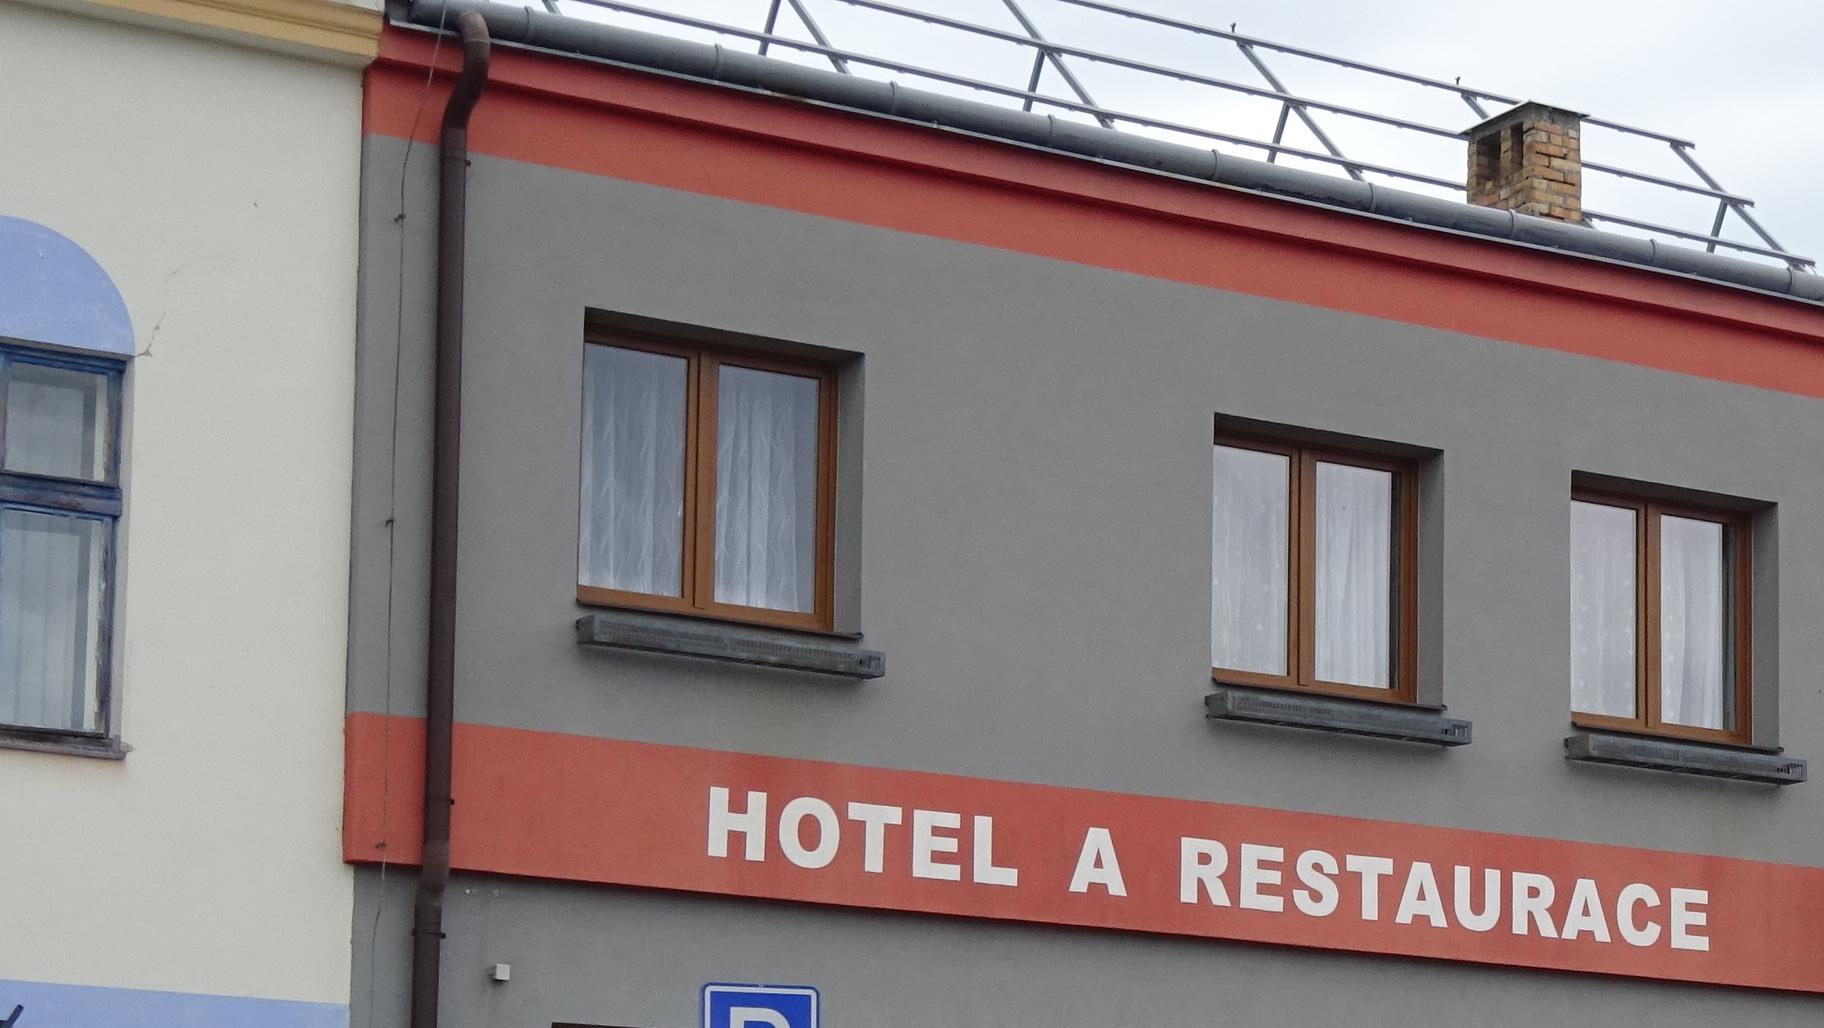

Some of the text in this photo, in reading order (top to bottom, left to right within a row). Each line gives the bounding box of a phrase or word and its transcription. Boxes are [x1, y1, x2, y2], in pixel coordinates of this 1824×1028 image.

[707, 785, 1710, 952] HOTEL A RESTAURACE
